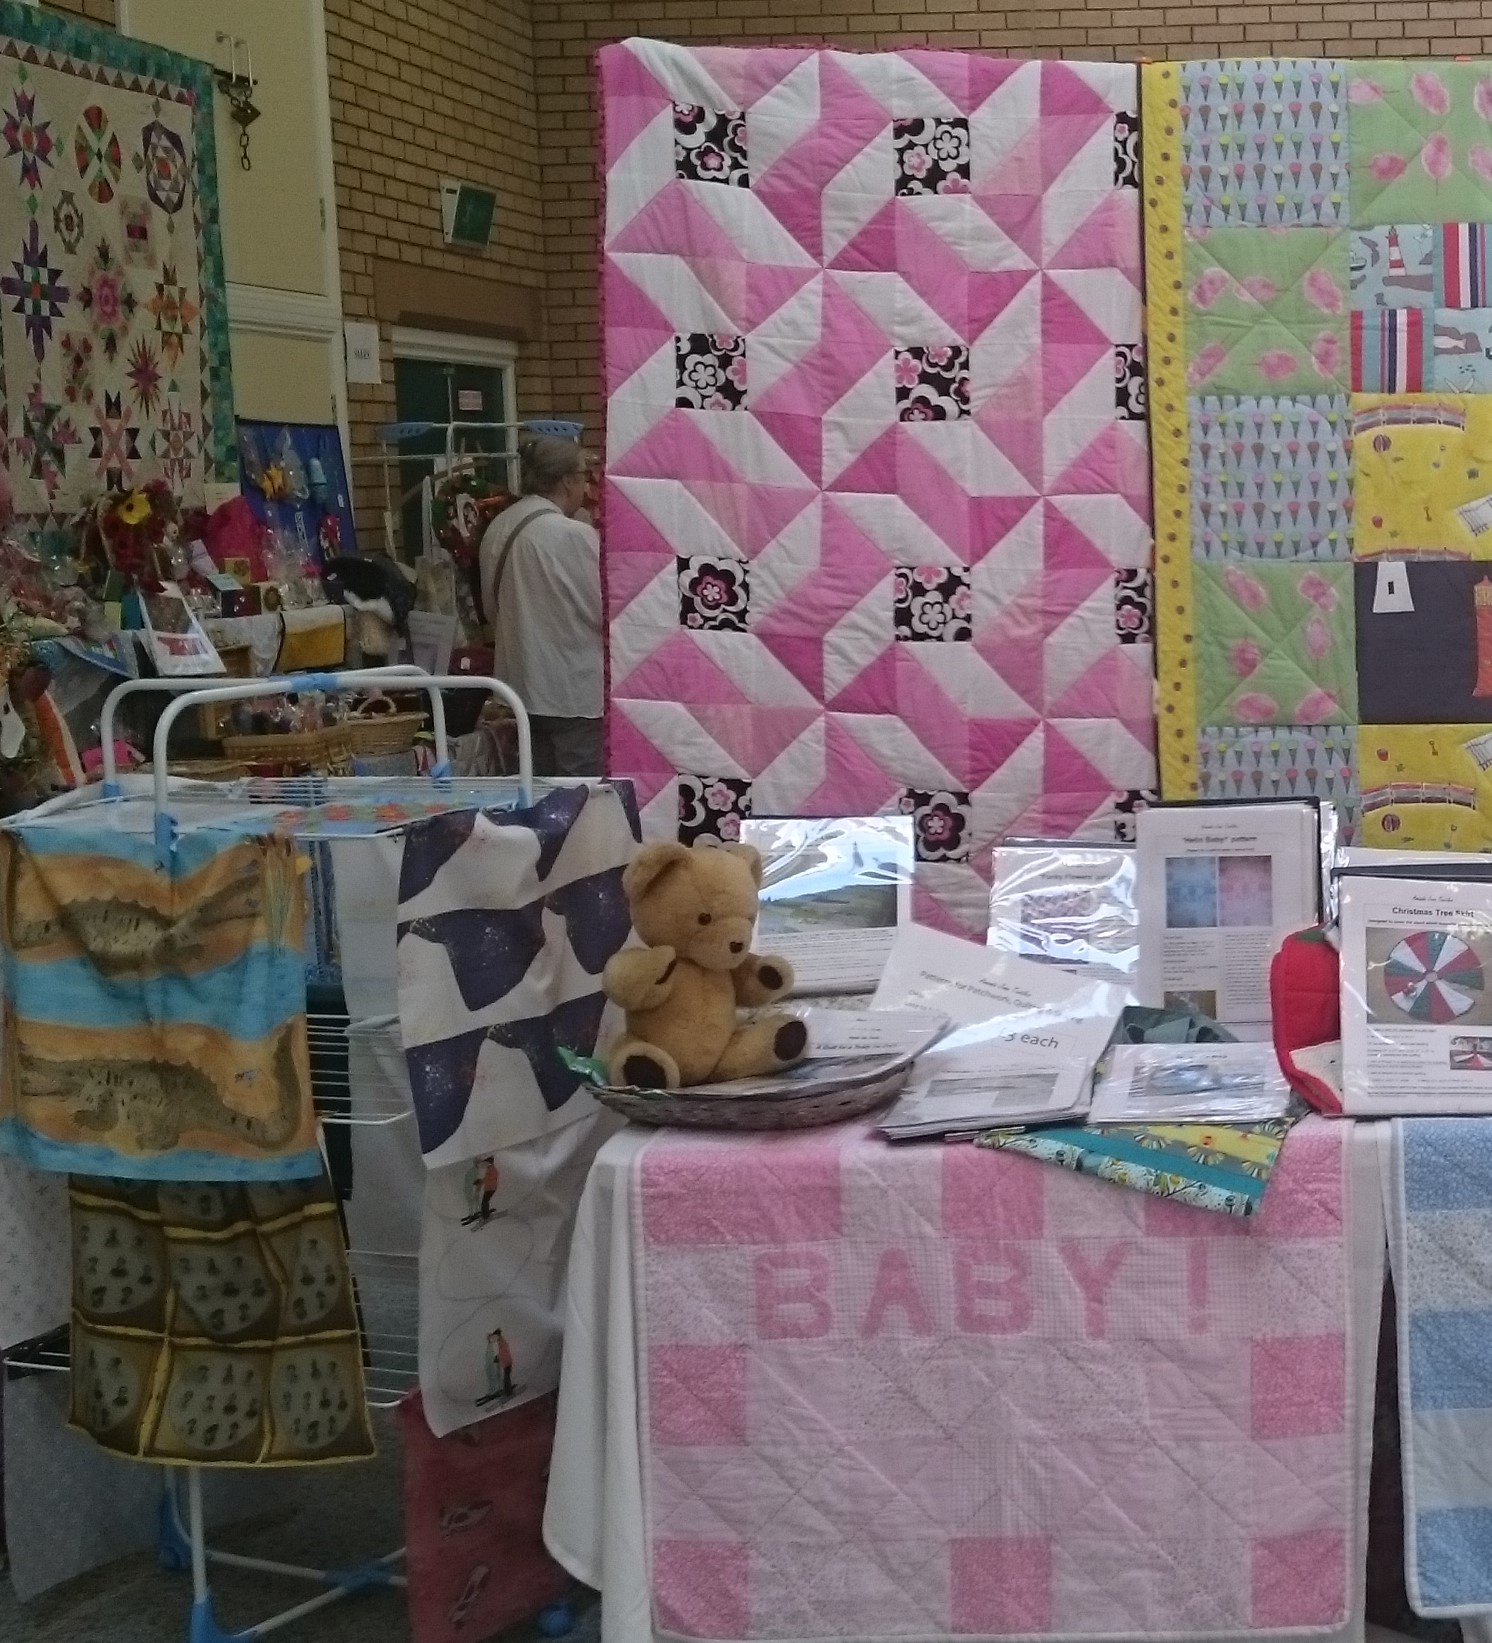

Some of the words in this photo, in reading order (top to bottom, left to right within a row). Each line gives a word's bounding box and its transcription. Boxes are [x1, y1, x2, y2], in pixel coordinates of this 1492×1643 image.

[1392, 907, 1433, 916] Christmas
[1435, 908, 1453, 917] Tree
[1455, 910, 1474, 918] Skirt
[1020, 1033, 1059, 1049] each
